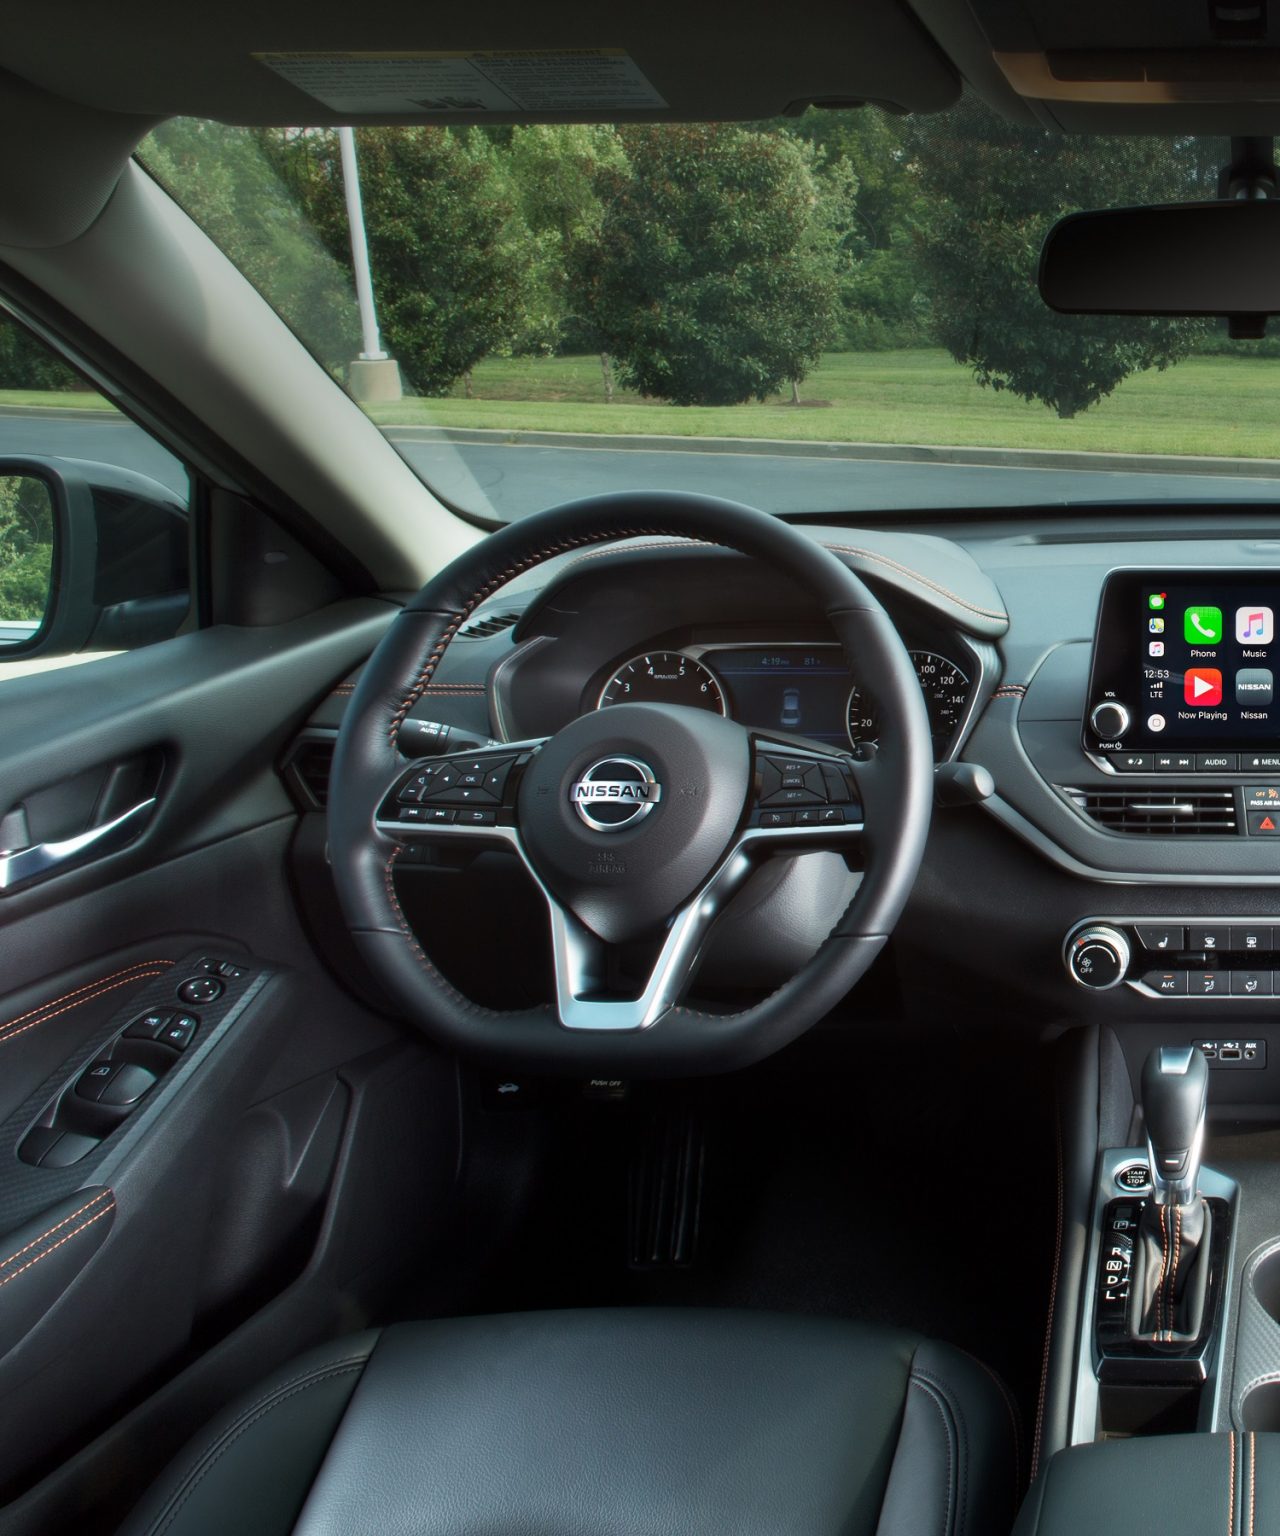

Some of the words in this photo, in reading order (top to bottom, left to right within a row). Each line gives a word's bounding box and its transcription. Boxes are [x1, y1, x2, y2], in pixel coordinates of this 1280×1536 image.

[1190, 649, 1216, 658] Phone
[1242, 649, 1267, 658] Music
[647, 666, 654, 675] 4
[679, 666, 685, 676] 5
[920, 665, 936, 674] 100
[1144, 670, 1169, 678] 12:53
[940, 676, 954, 685] 120
[624, 683, 630, 692] 3
[700, 683, 707, 692] 6
[1237, 683, 1271, 691] NISSAN
[1178, 711, 1196, 719] Now
[1198, 711, 1228, 721] Playing
[1240, 711, 1268, 719] Nissan
[860, 719, 874, 727] 20
[419, 727, 438, 735] AUTO
[1204, 758, 1227, 766] AUDIO
[576, 785, 650, 798] NISSAN
[590, 1079, 608, 1087] PUSH
[1111, 1247, 1121, 1255] R
[1107, 1275, 1118, 1284] D
[1105, 1290, 1115, 1299] L
